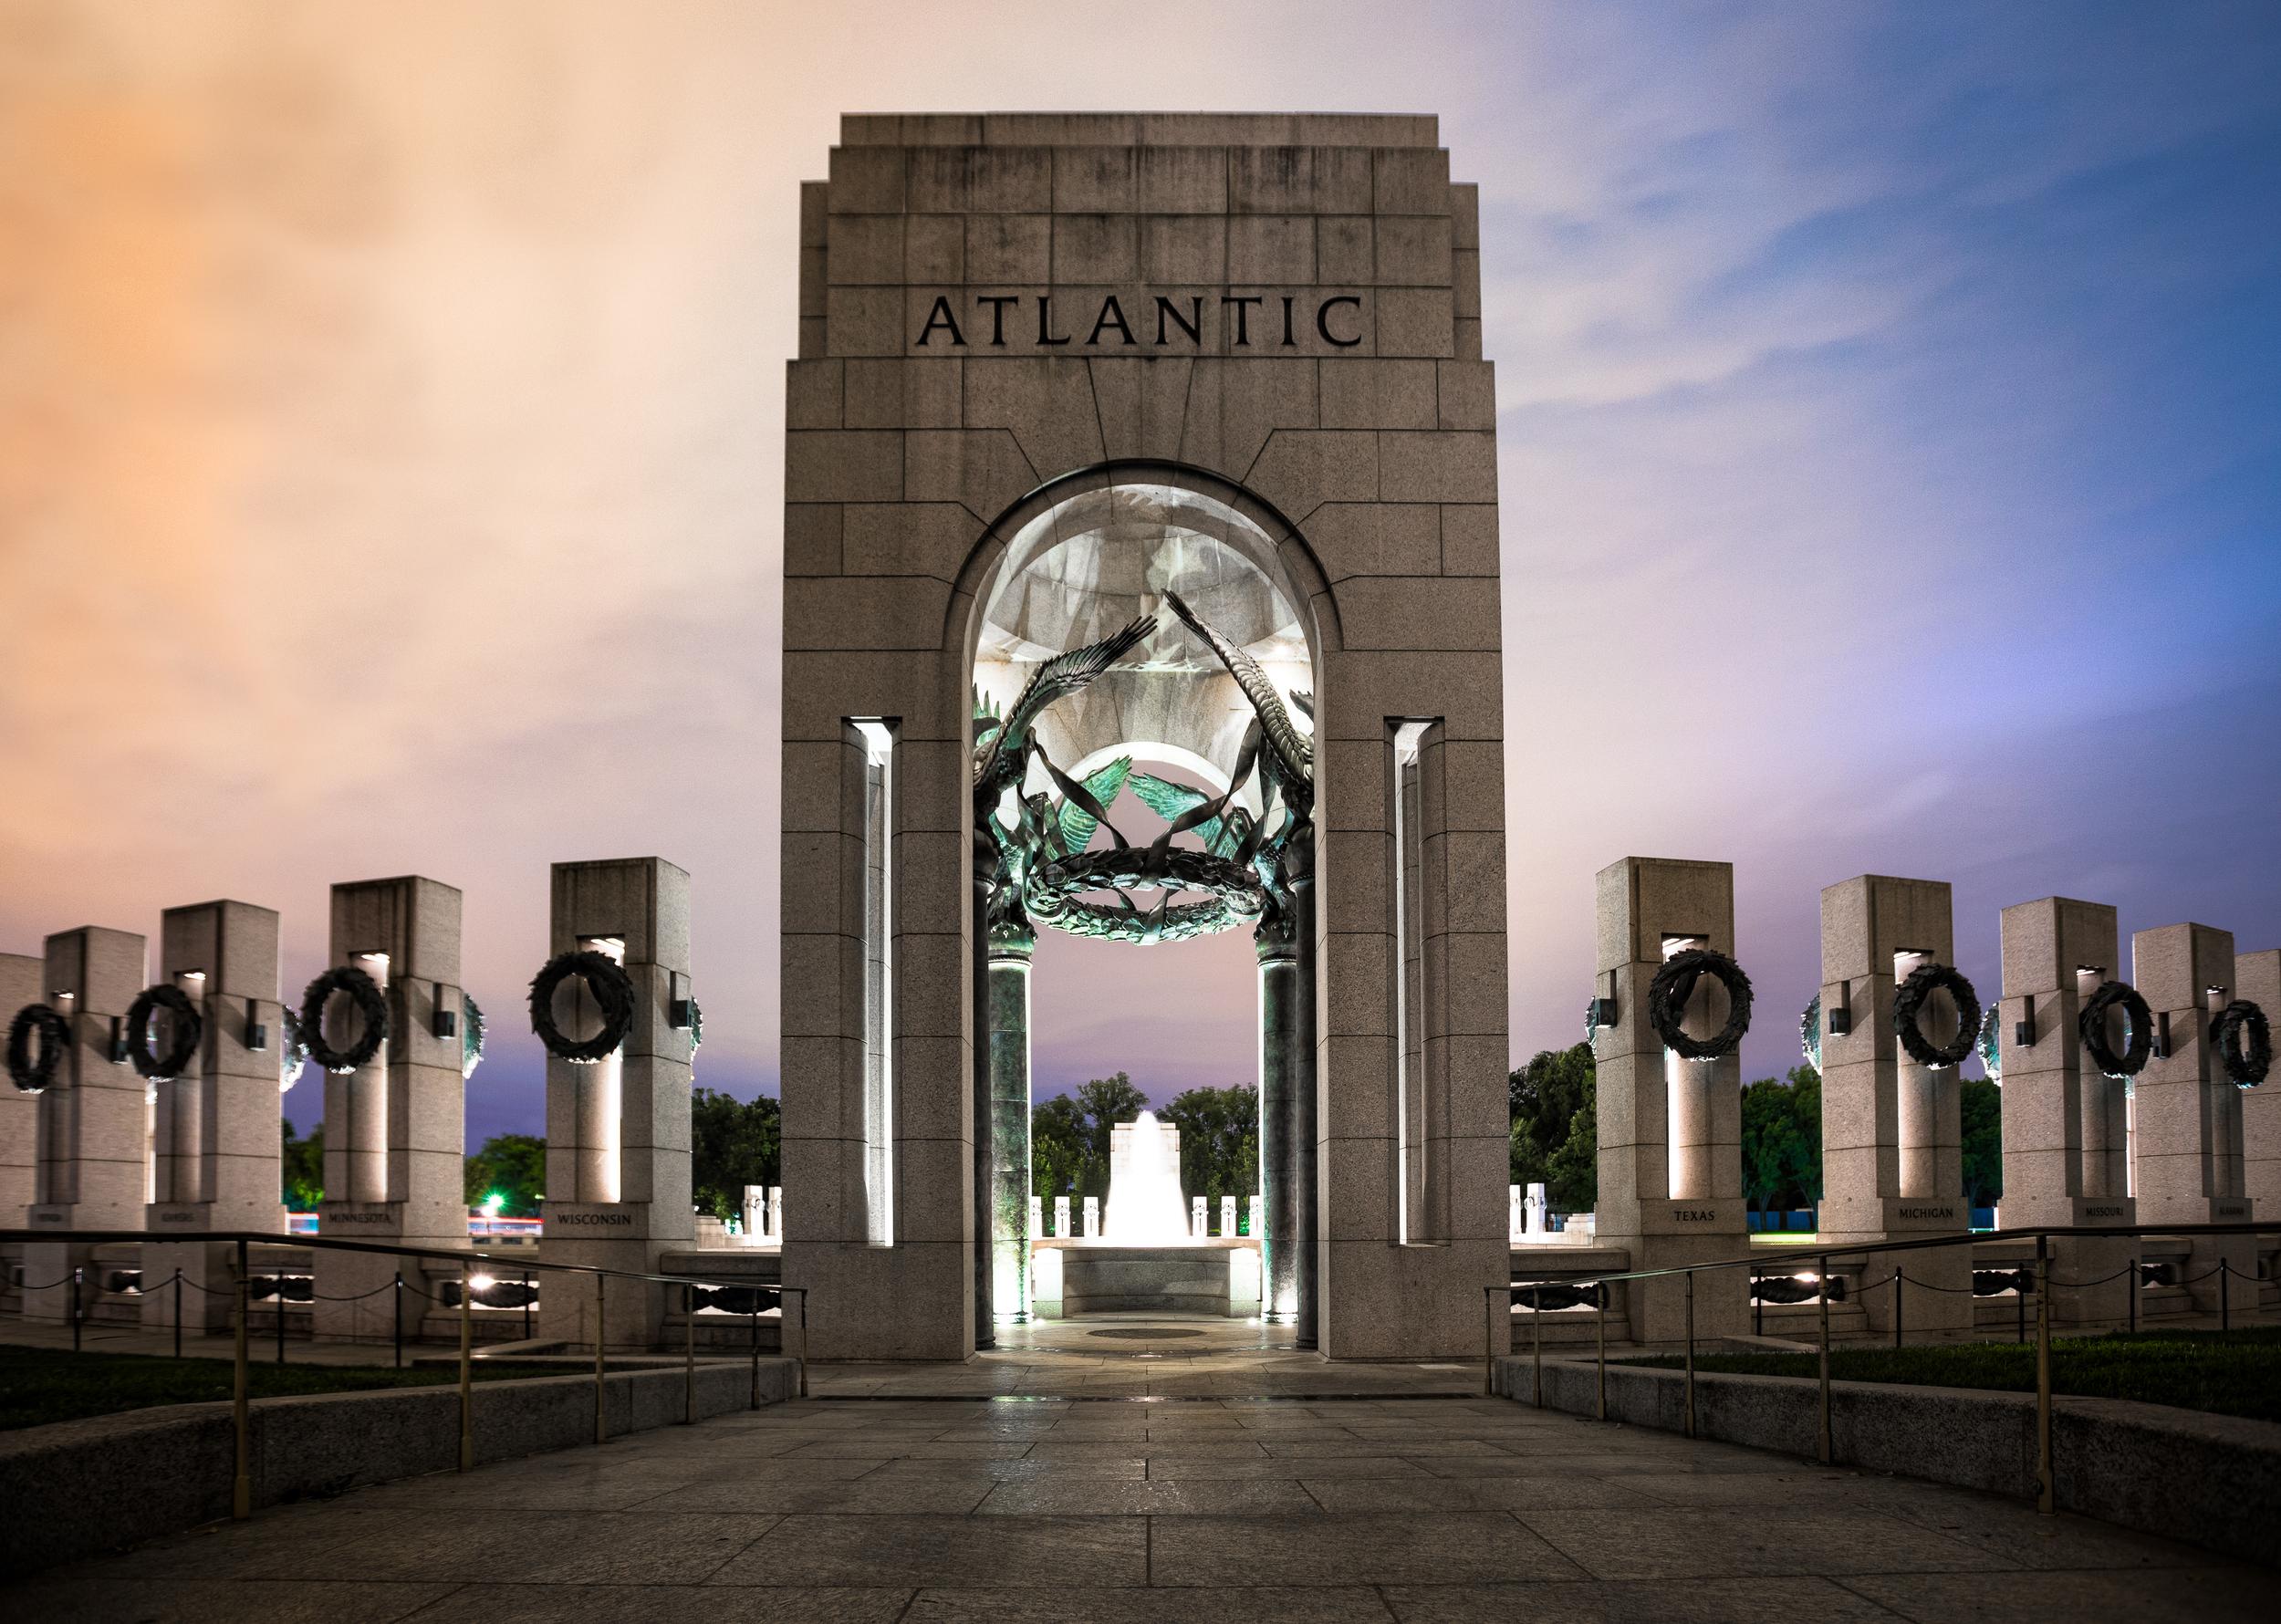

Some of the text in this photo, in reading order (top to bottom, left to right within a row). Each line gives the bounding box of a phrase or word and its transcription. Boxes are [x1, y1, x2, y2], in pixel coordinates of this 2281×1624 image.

[914, 294, 1363, 348] ATLANTIC
[1673, 1210, 1715, 1222] TEXAS
[1899, 1207, 1953, 1219] MICHIGAN
[2086, 1206, 2124, 1217] MISSOURI
[557, 1213, 631, 1225] WISCONSIN
